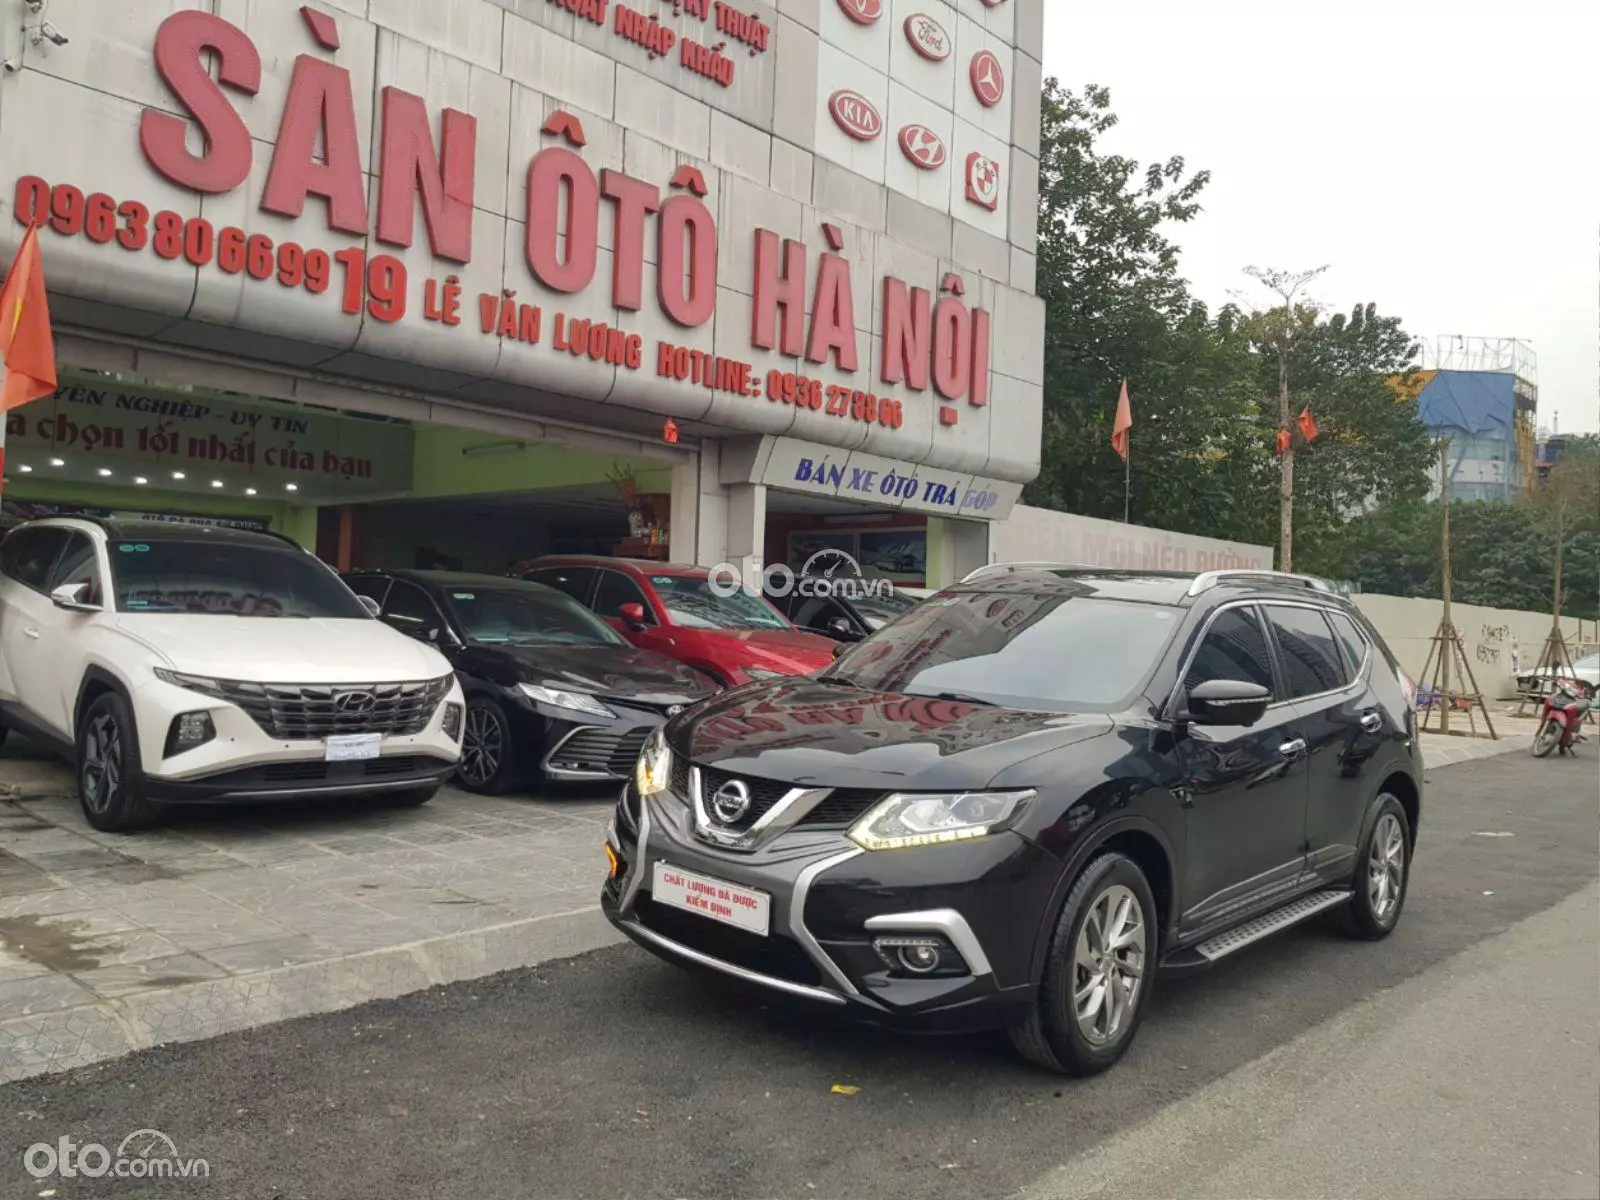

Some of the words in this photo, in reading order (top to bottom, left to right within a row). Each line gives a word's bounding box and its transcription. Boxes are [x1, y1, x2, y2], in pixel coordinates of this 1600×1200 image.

[614, 4, 676, 60] NHẬP
[714, 0, 771, 57] THUẬT
[844, 99, 875, 131] KIA
[139, 6, 477, 264] SÀN
[522, 109, 718, 328] ÔTÔ
[750, 222, 858, 373] HÀ
[880, 272, 989, 426] NỘI
[423, 274, 462, 326] LÊ
[479, 288, 541, 344] VĂN
[553, 312, 642, 370] LƯƠNG
[115, 392, 210, 421] NGHIỆP
[37, 413, 124, 451] chọn
[138, 420, 180, 455] tốt
[187, 431, 256, 464] nhất
[264, 440, 315, 472] của
[322, 450, 372, 480] bạn
[794, 454, 847, 490] BÁN
[847, 467, 878, 493] XE
[879, 467, 919, 500] ÔTÔ
[961, 484, 999, 511] GÓP
